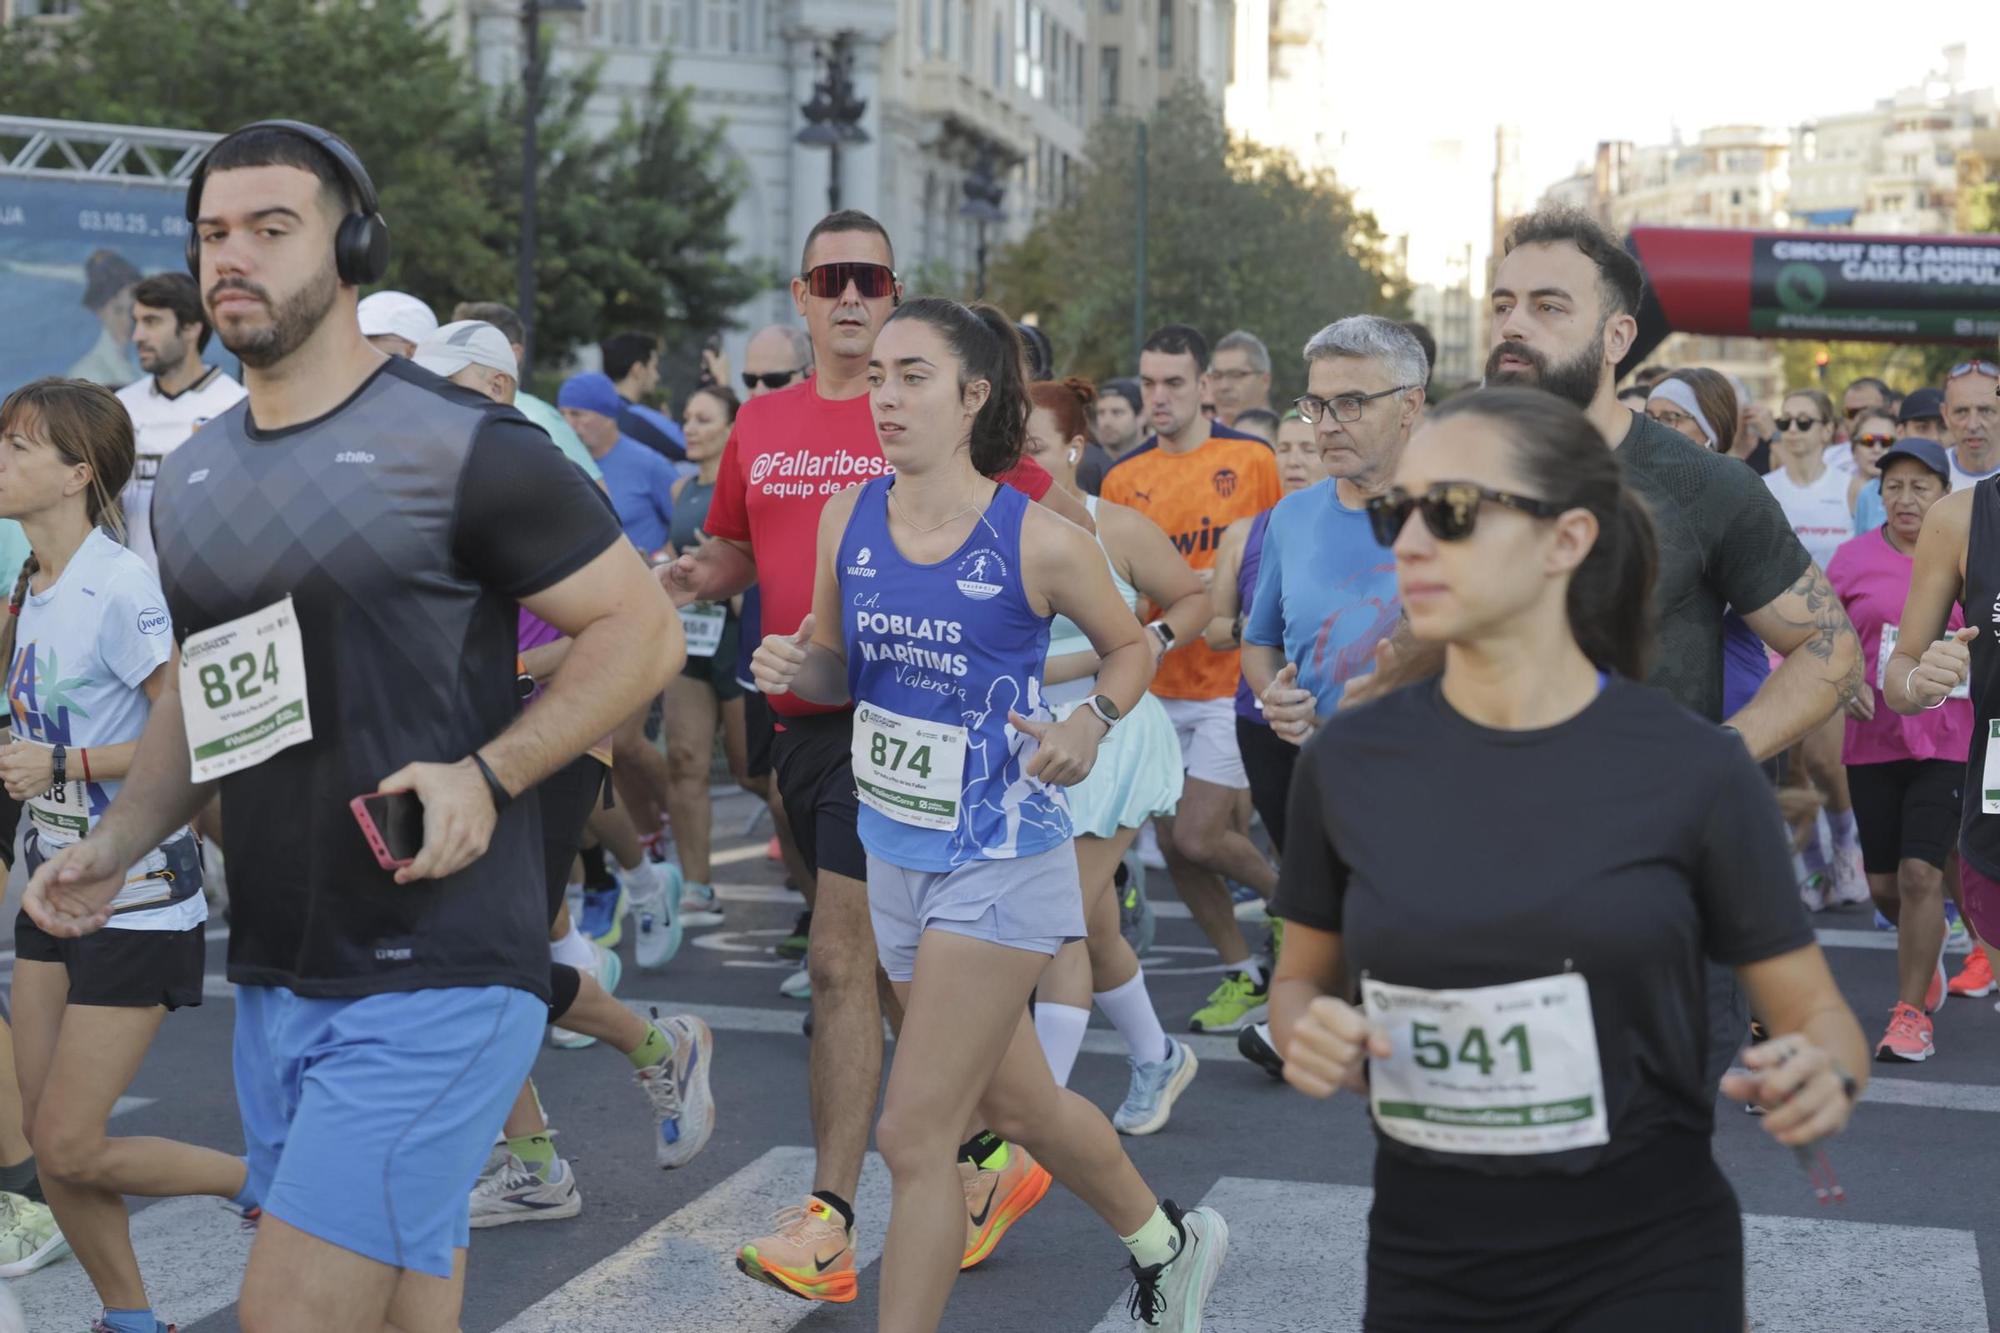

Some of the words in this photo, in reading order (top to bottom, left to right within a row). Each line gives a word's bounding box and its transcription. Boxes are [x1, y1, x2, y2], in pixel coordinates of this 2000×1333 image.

[1772, 241, 1865, 262] CIRCUIT
[1868, 245, 1900, 261] DE
[762, 480, 815, 499] equip
[818, 479, 841, 495] de
[846, 566, 877, 578] VIATOR
[856, 611, 962, 644] POBLATS
[198, 641, 279, 709] 824
[858, 640, 969, 677] MARÍTIMS
[894, 663, 967, 701] València
[870, 731, 932, 779] 874
[1410, 1020, 1533, 1076] 541
